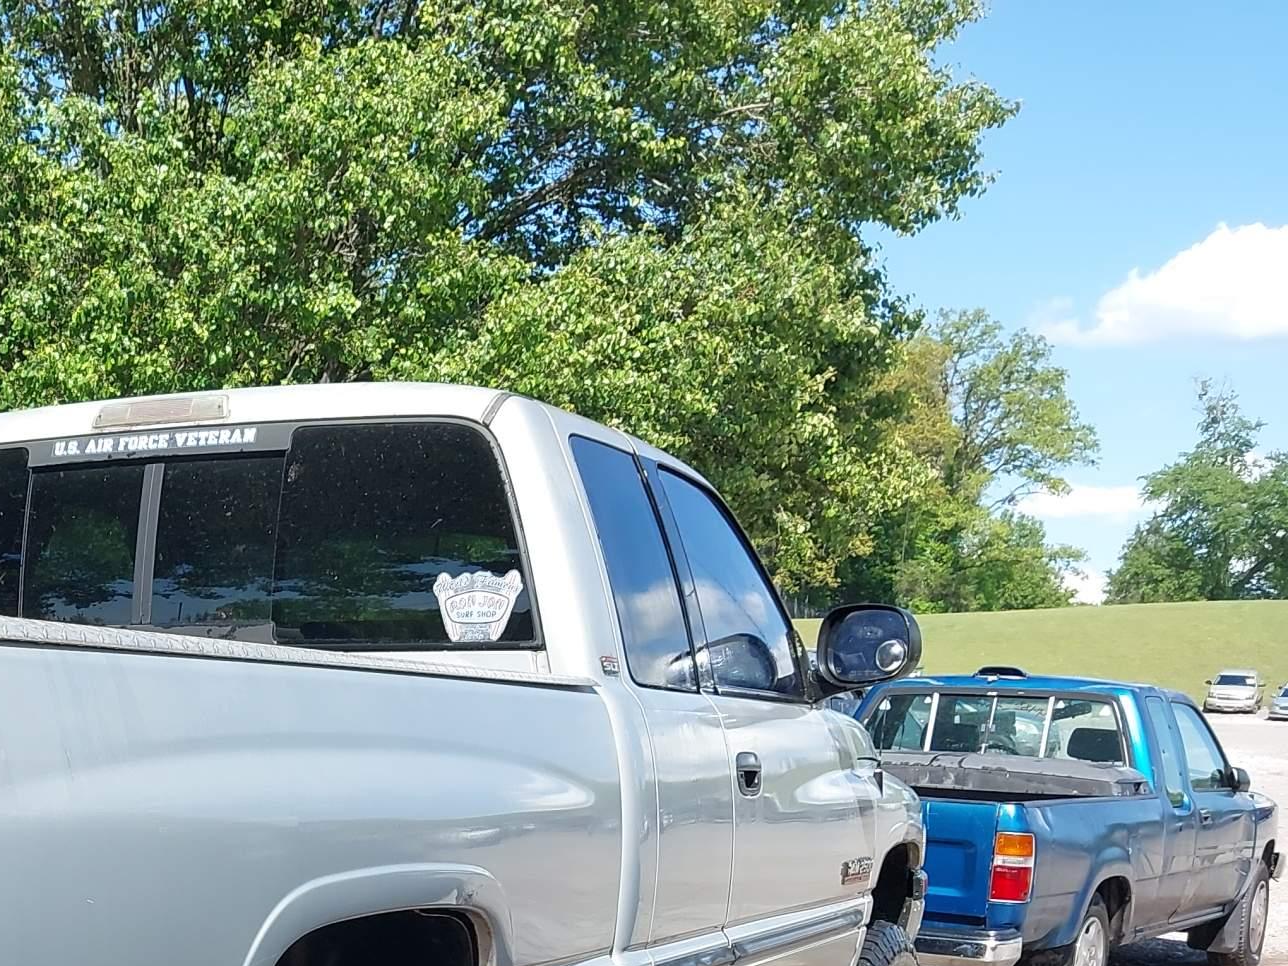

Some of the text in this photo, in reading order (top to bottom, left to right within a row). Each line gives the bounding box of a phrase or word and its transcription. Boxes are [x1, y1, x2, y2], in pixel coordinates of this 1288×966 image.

[54, 427, 257, 456] U.S. AIR FORCE VETERAN
[479, 596, 505, 610] JON
[456, 611, 474, 619] SURF
